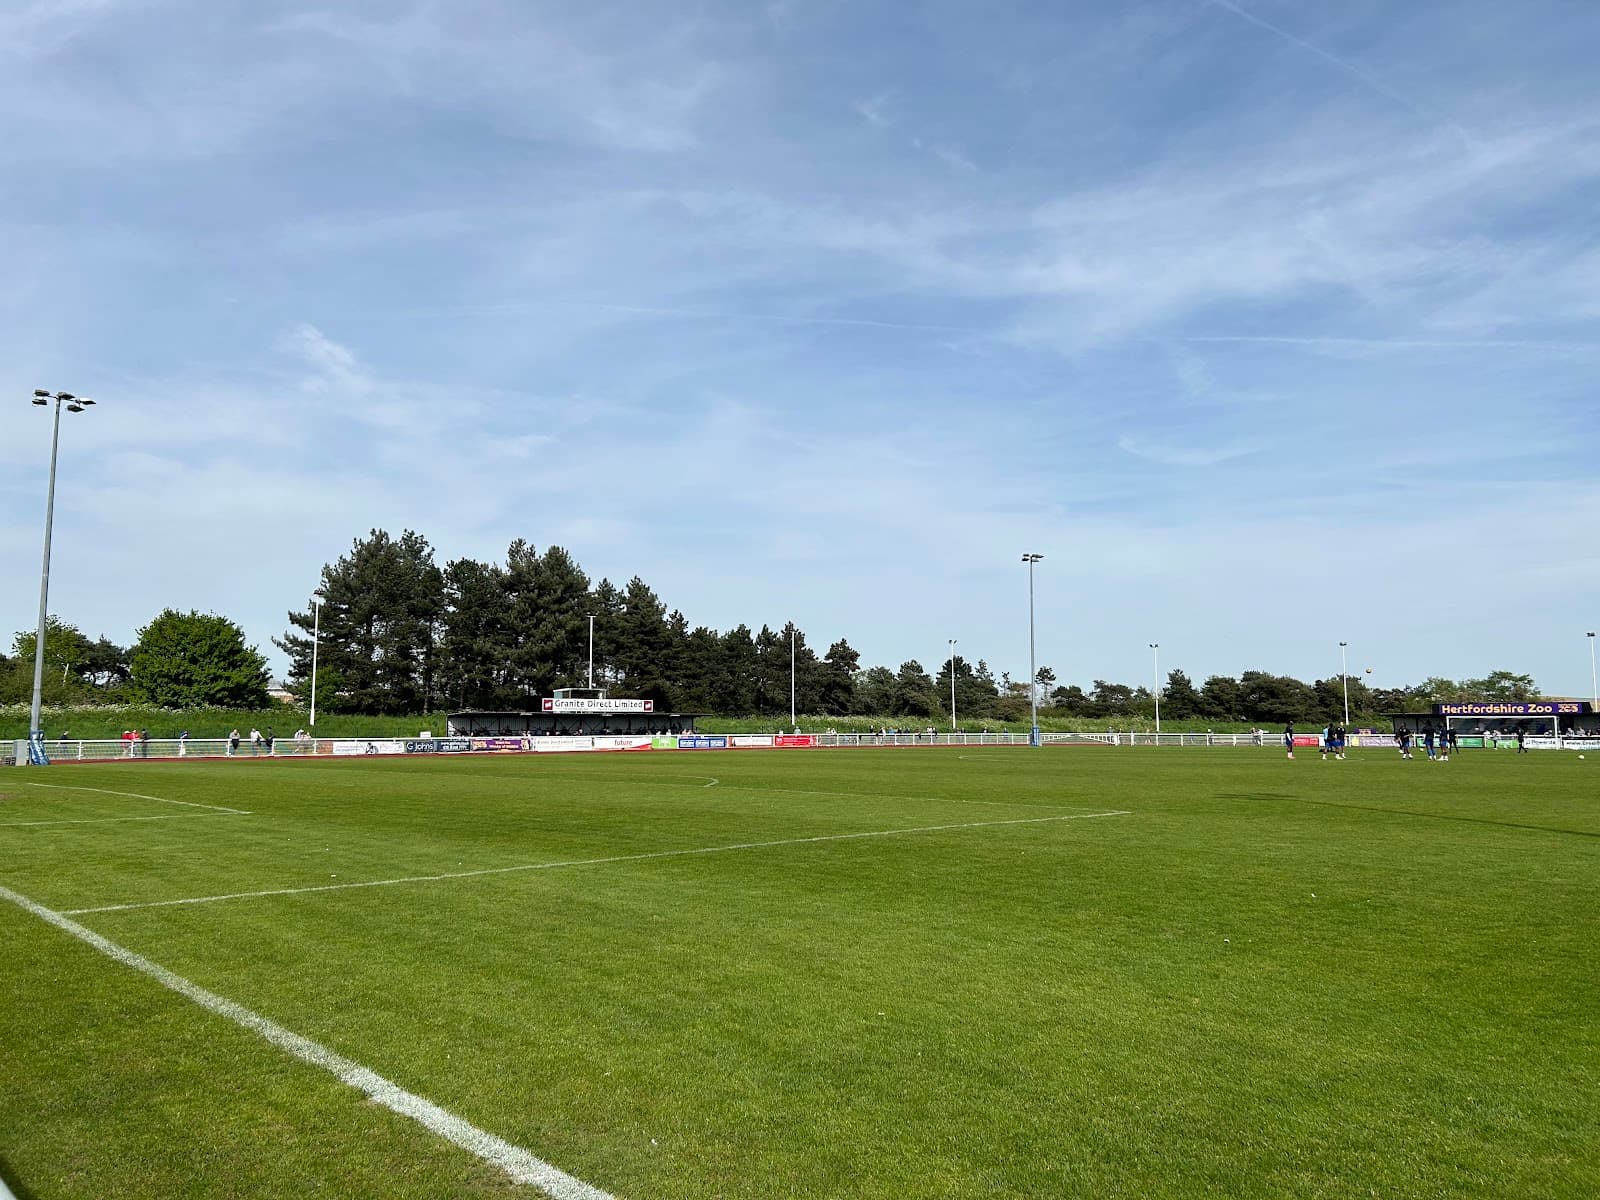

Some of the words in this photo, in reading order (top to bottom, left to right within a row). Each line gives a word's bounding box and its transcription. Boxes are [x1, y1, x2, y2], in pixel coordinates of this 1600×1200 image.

[554, 700, 585, 708] Granite
[587, 700, 612, 708] Direct
[614, 700, 643, 708] Limited
[1441, 704, 1525, 714] Hertfordshire
[1527, 703, 1553, 713] Zoo
